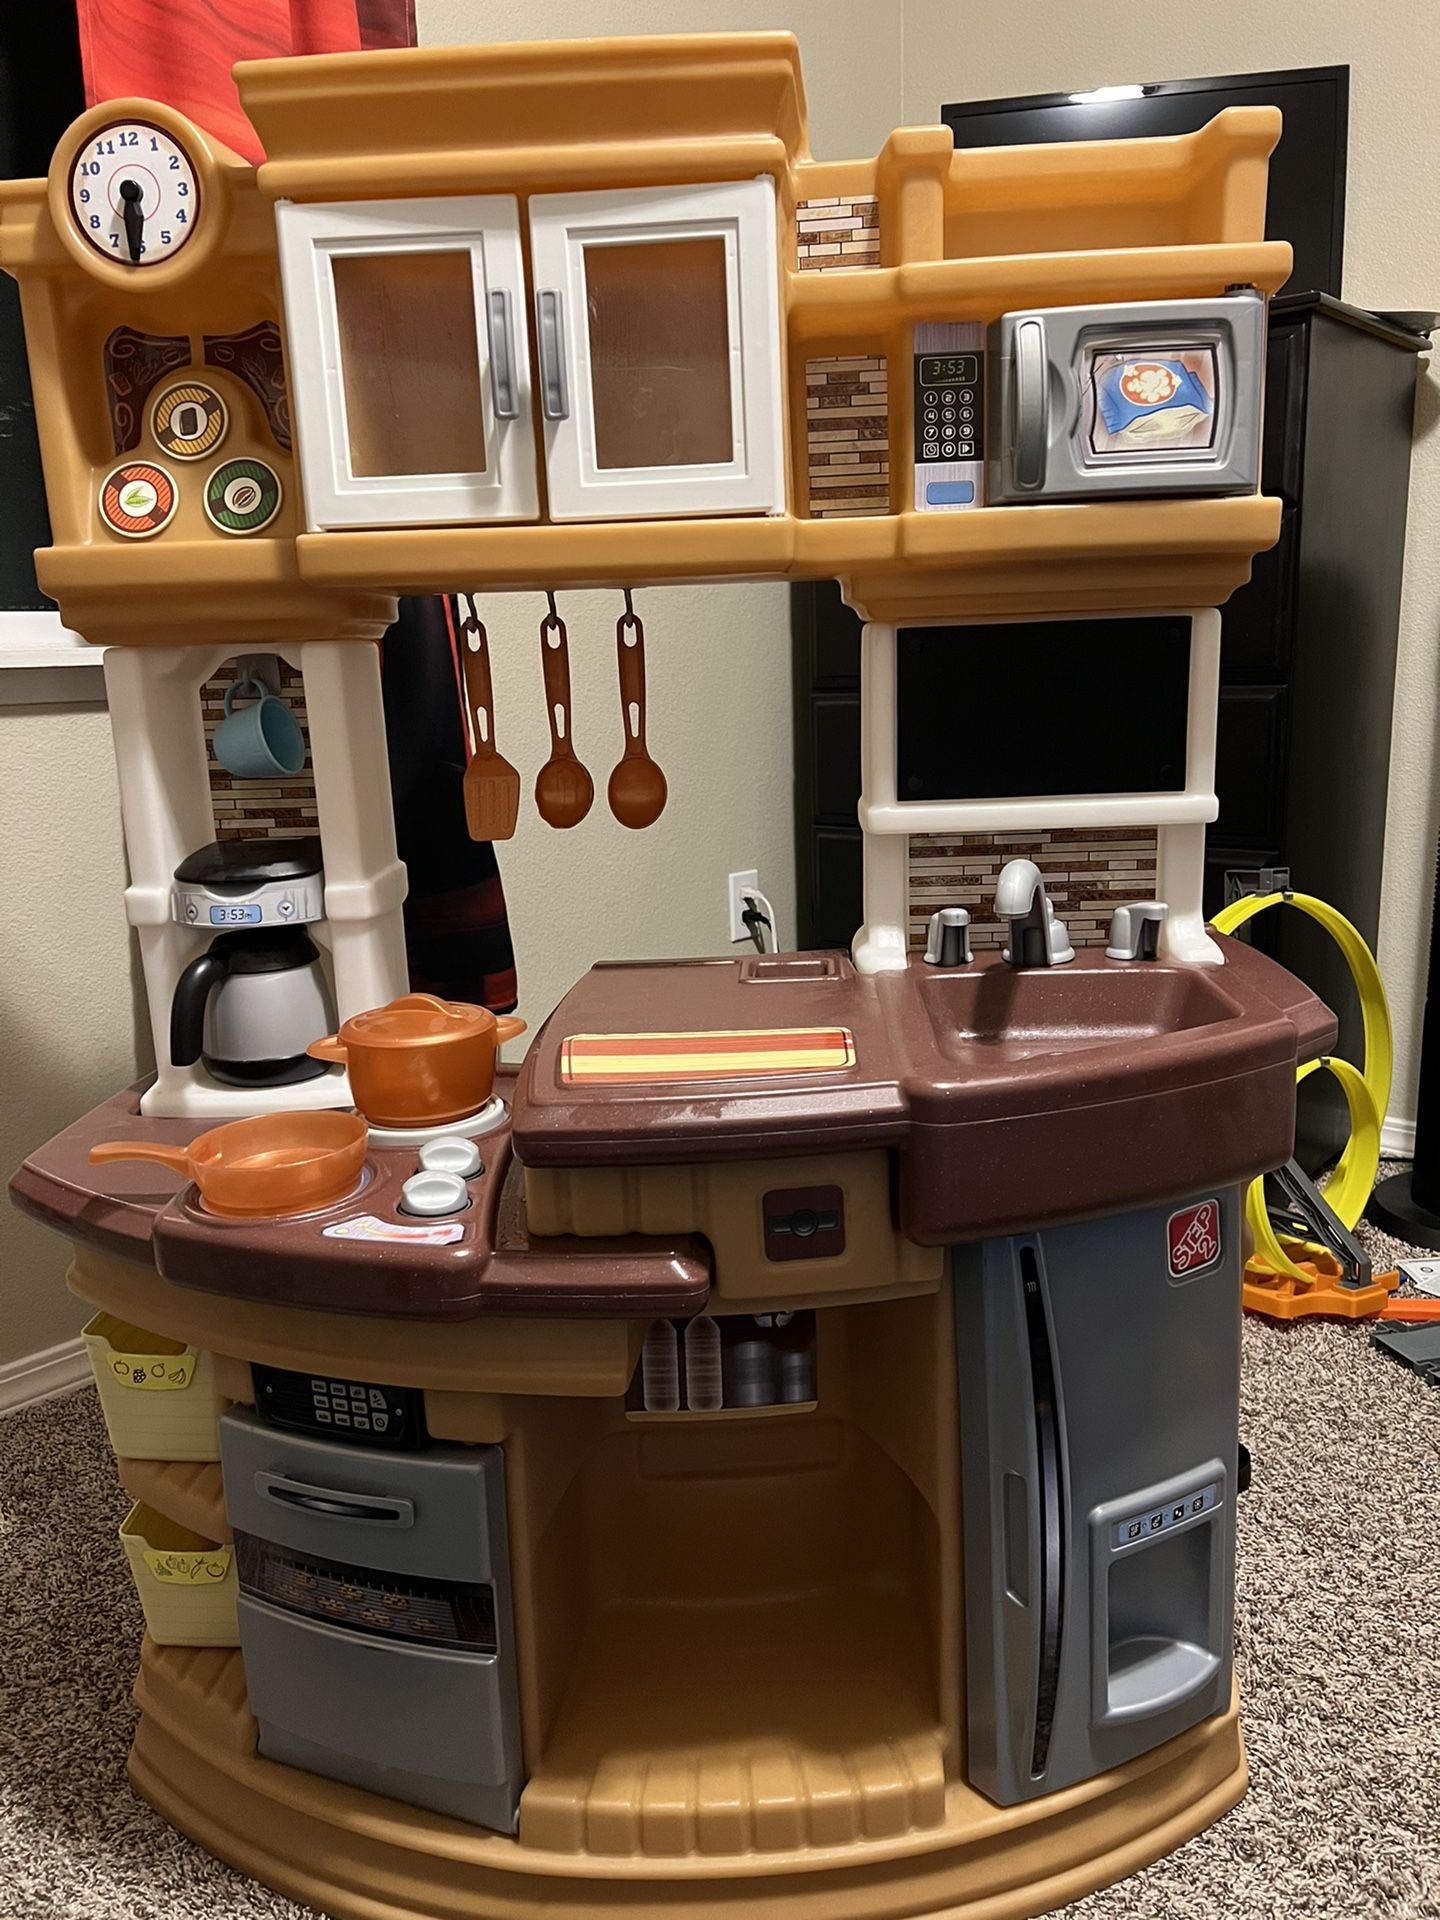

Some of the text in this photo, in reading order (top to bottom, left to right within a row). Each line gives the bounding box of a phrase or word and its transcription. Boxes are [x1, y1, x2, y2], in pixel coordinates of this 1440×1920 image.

[119, 132, 139, 147] 12
[150, 137, 159, 151] 1
[96, 140, 115, 155] 11
[80, 161, 101, 176] 10
[169, 155, 180, 170] 2
[79, 189, 91, 203] 9
[177, 182, 189, 196] 3
[90, 215, 101, 229] 8
[176, 208, 187, 223] 4
[109, 233, 120, 248] 7
[160, 231, 172, 244] 5
[932, 359, 965, 376] 3:53
[1172, 1204, 1212, 1270] STEP
[1197, 1234, 1217, 1260] 2
